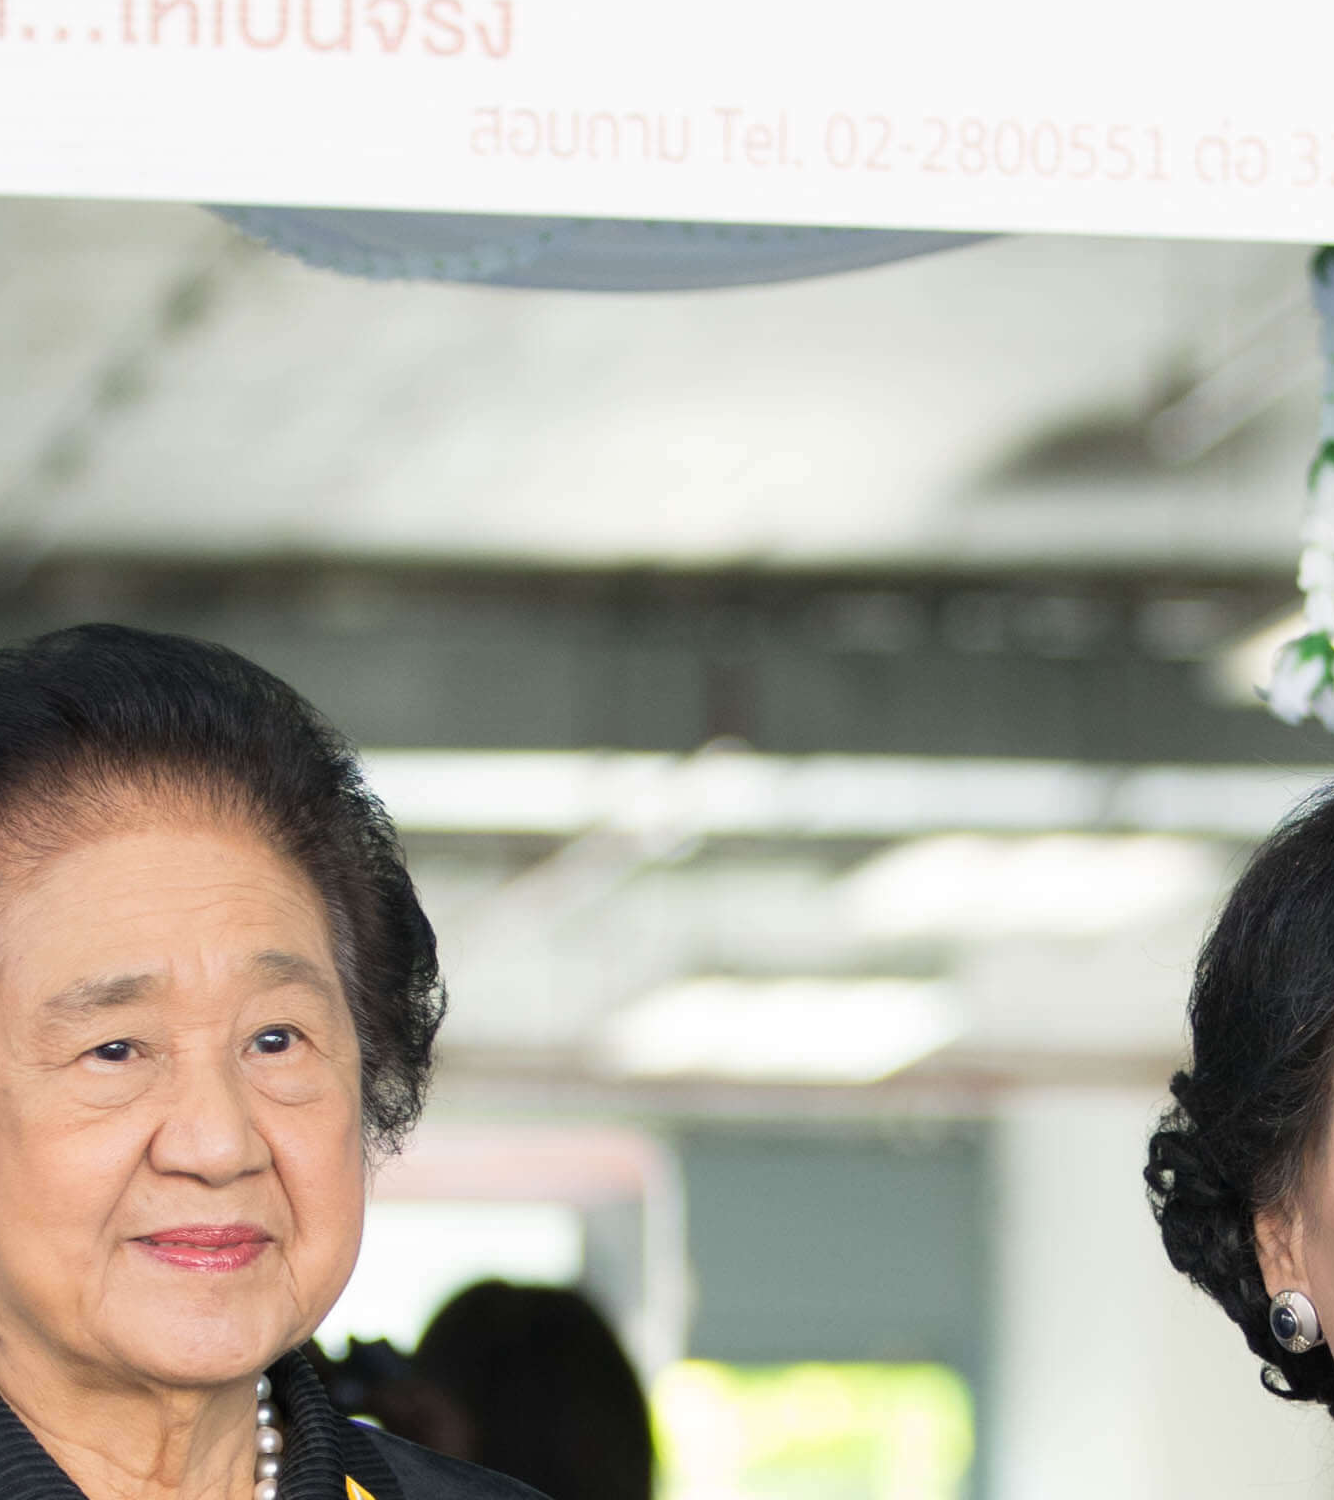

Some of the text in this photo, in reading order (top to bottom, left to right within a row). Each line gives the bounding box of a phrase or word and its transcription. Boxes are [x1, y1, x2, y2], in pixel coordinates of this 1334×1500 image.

[468, 103, 691, 166] สอบถาม
[713, 105, 805, 172] Tel.
[824, 110, 1171, 184] 02-2800551
[1192, 118, 1271, 187] ต่อ
